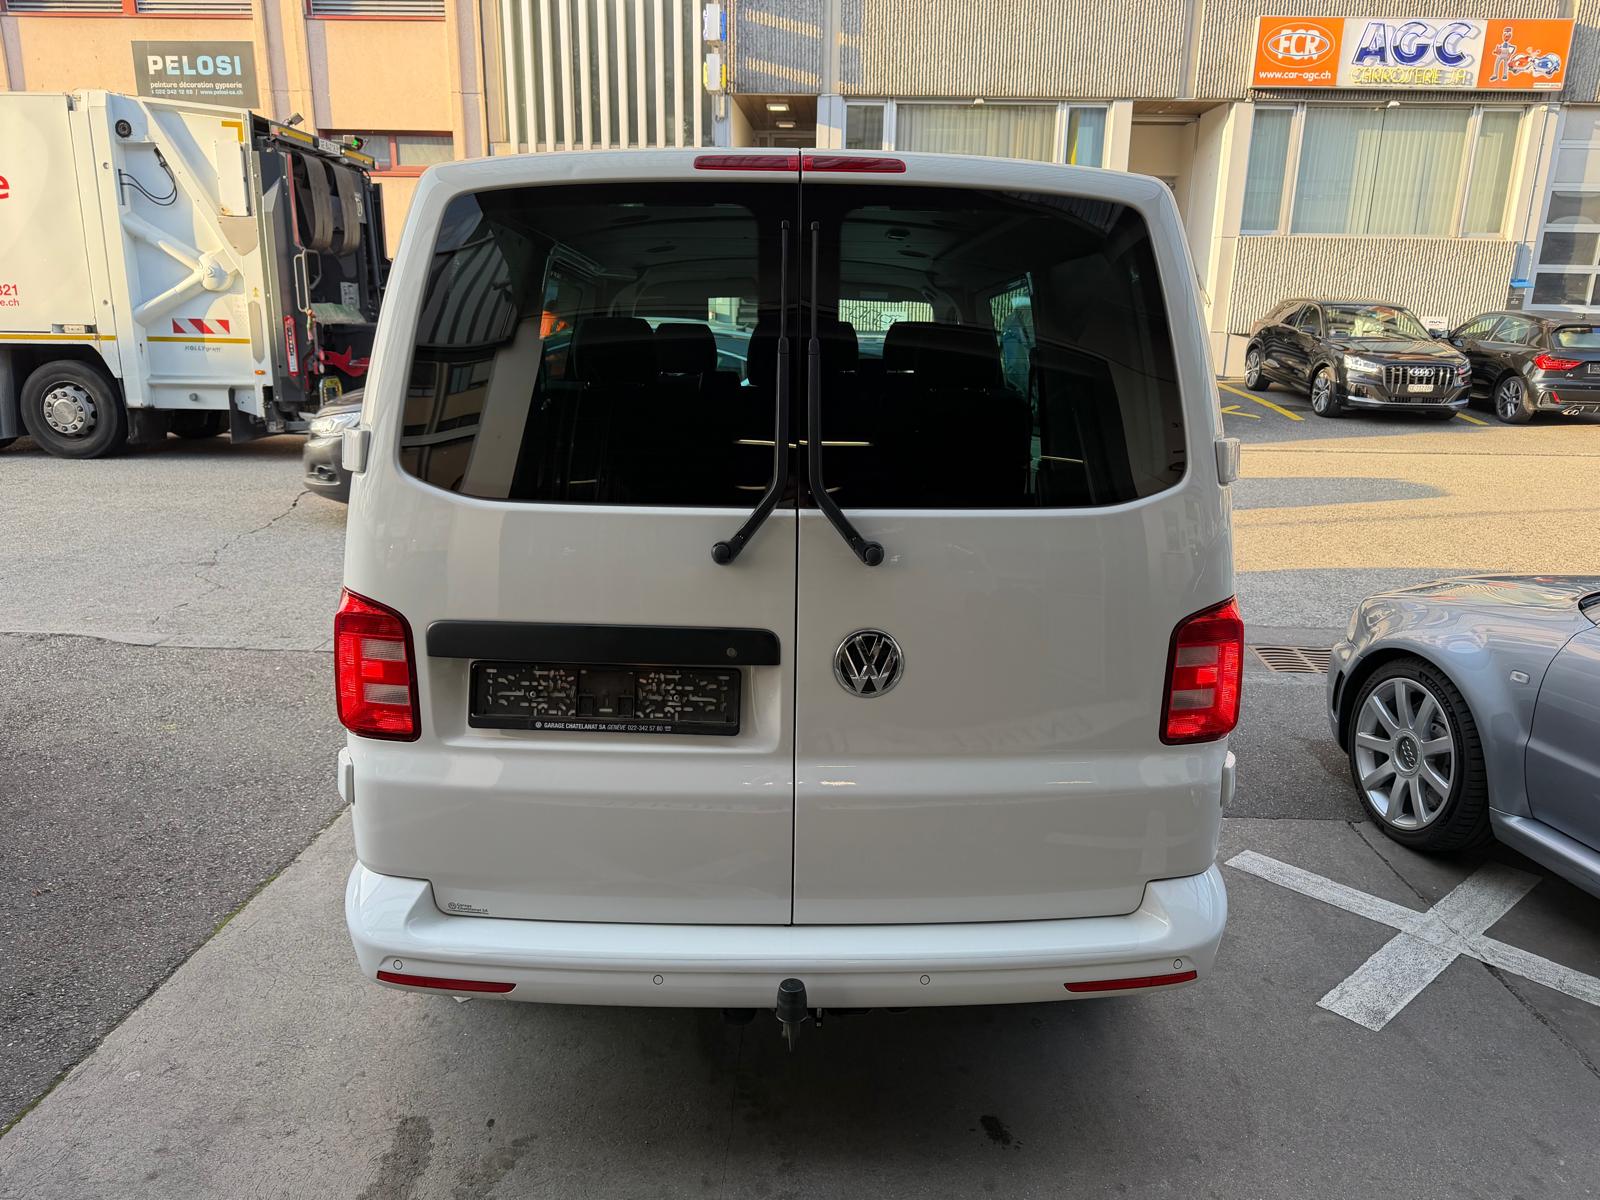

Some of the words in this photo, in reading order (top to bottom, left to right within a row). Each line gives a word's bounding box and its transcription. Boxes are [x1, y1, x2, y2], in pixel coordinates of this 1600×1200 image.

[1277, 29, 1321, 60] FCR
[1352, 21, 1472, 67] AGC
[146, 55, 243, 76] PELOSI
[1259, 71, 1331, 82] www.car-agc.ch
